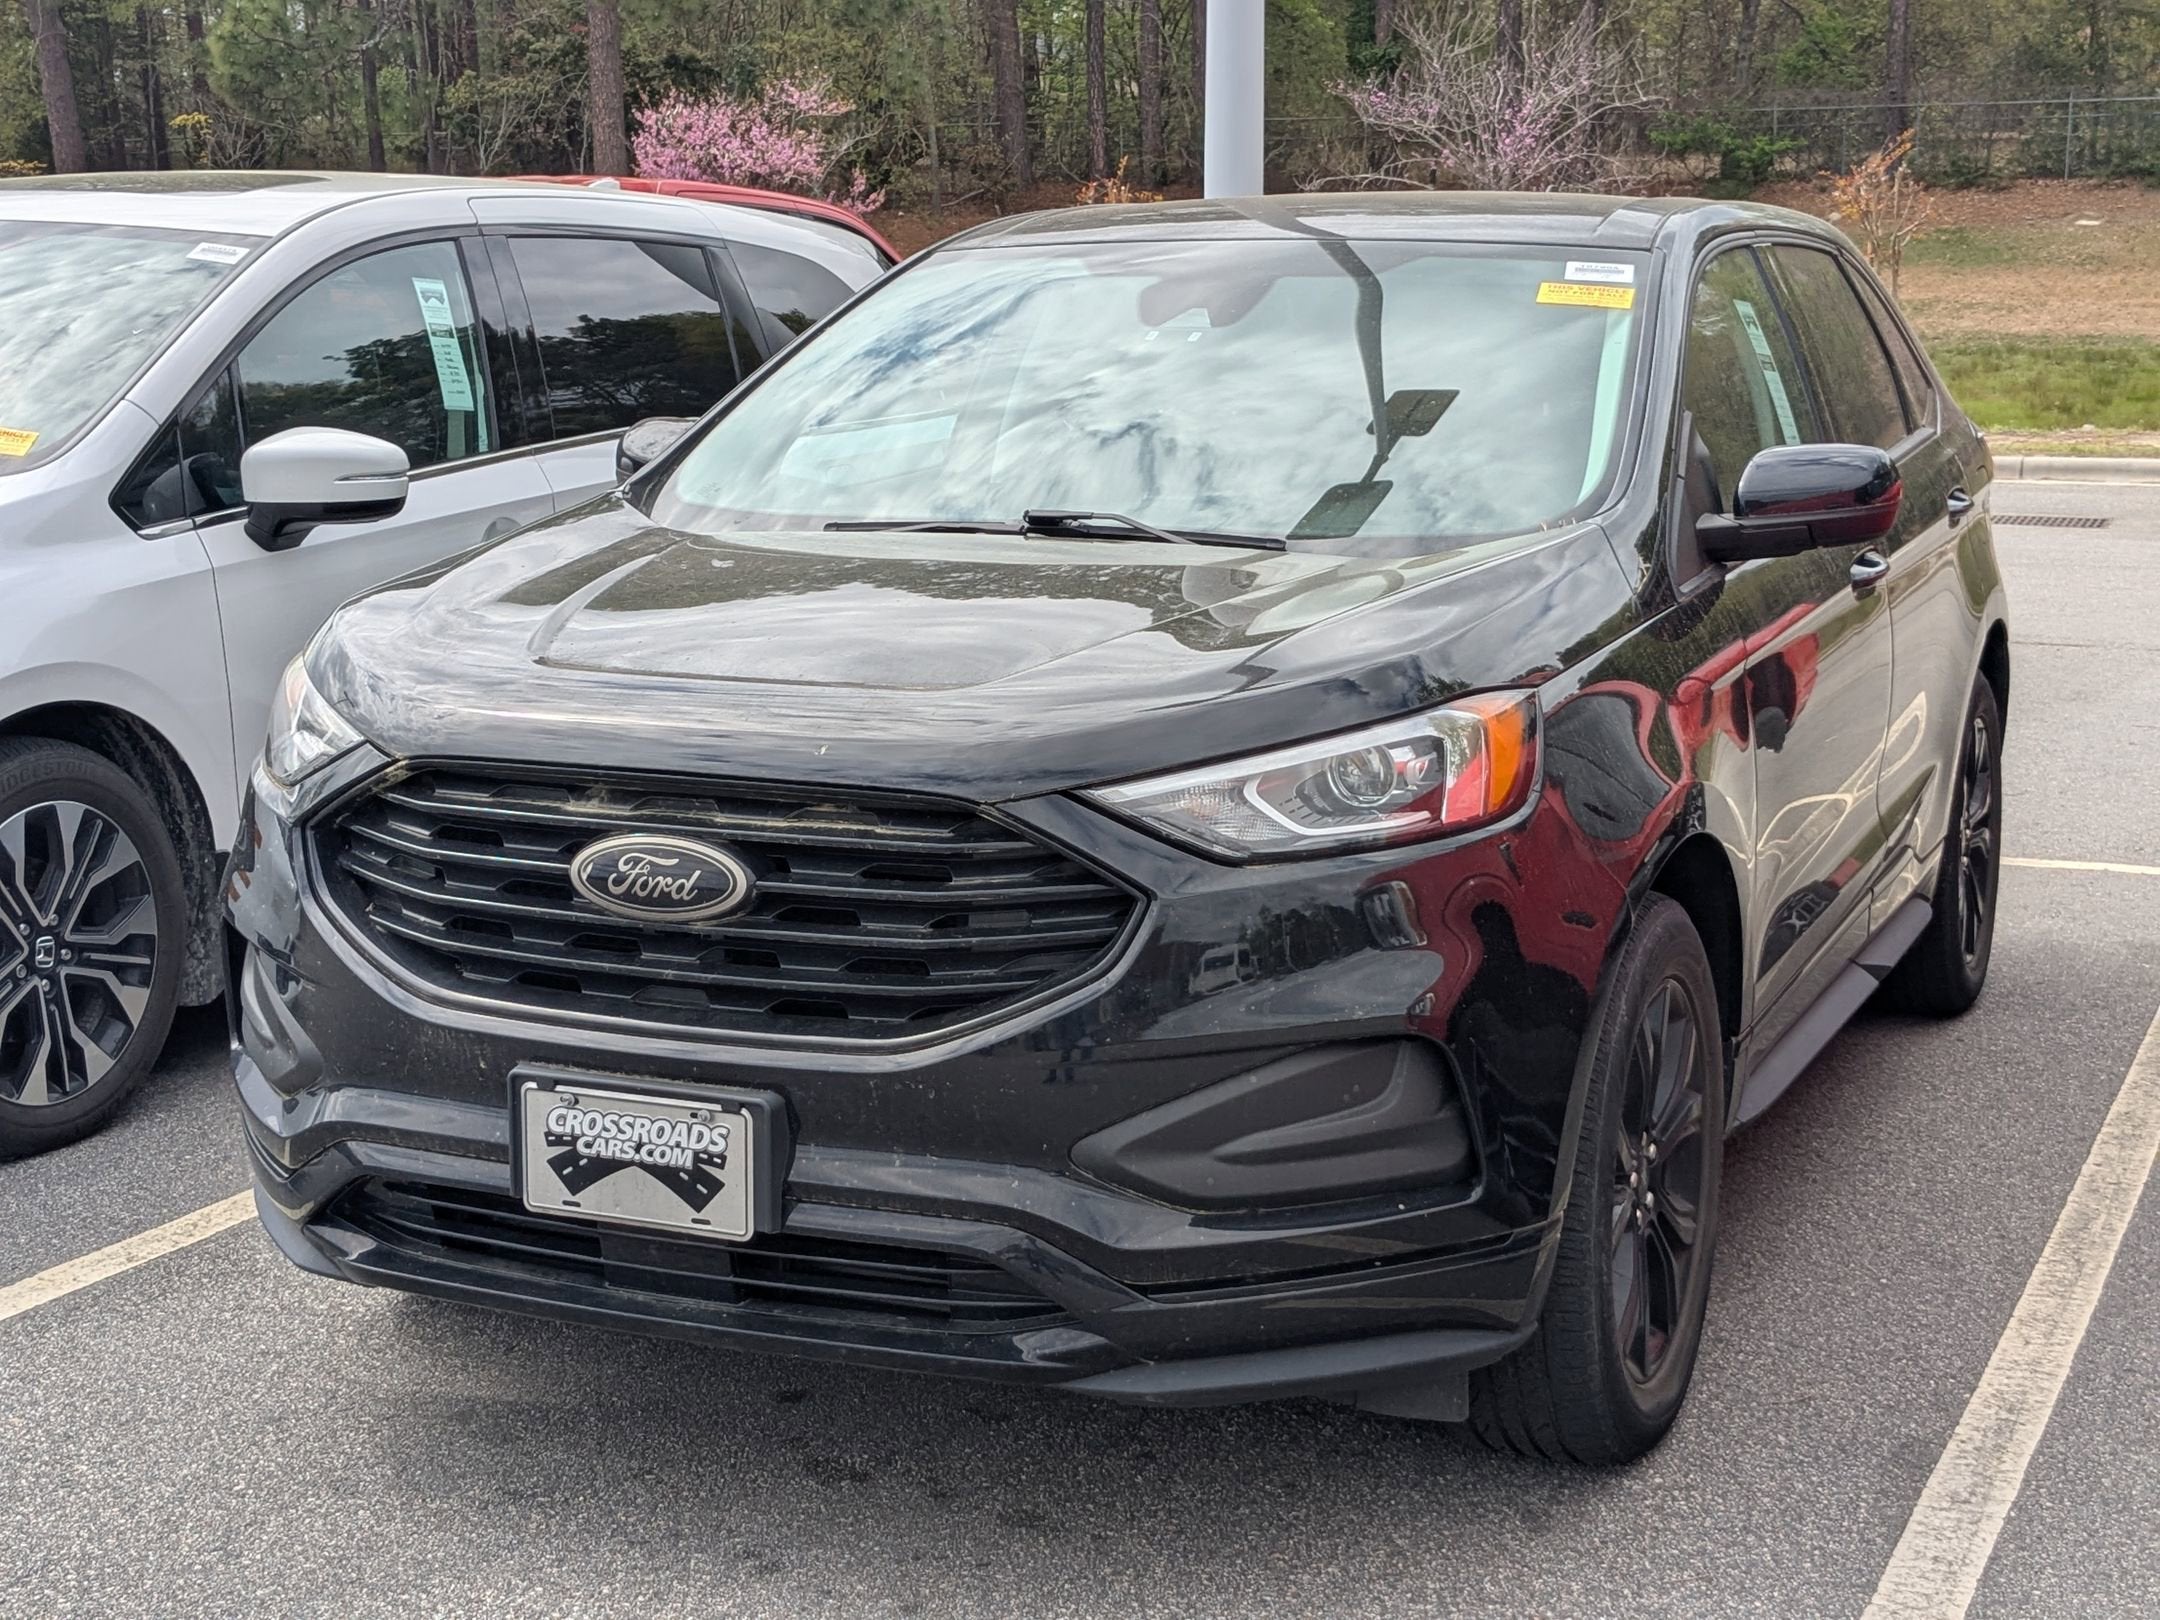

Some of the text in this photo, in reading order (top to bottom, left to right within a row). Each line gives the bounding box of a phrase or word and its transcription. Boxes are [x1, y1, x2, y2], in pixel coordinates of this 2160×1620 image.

[1578, 286, 1627, 294] VEHICLE
[607, 852, 702, 901] Ford
[547, 1106, 730, 1152] CROSSROADS
[576, 1136, 694, 1169] CARS.COM
